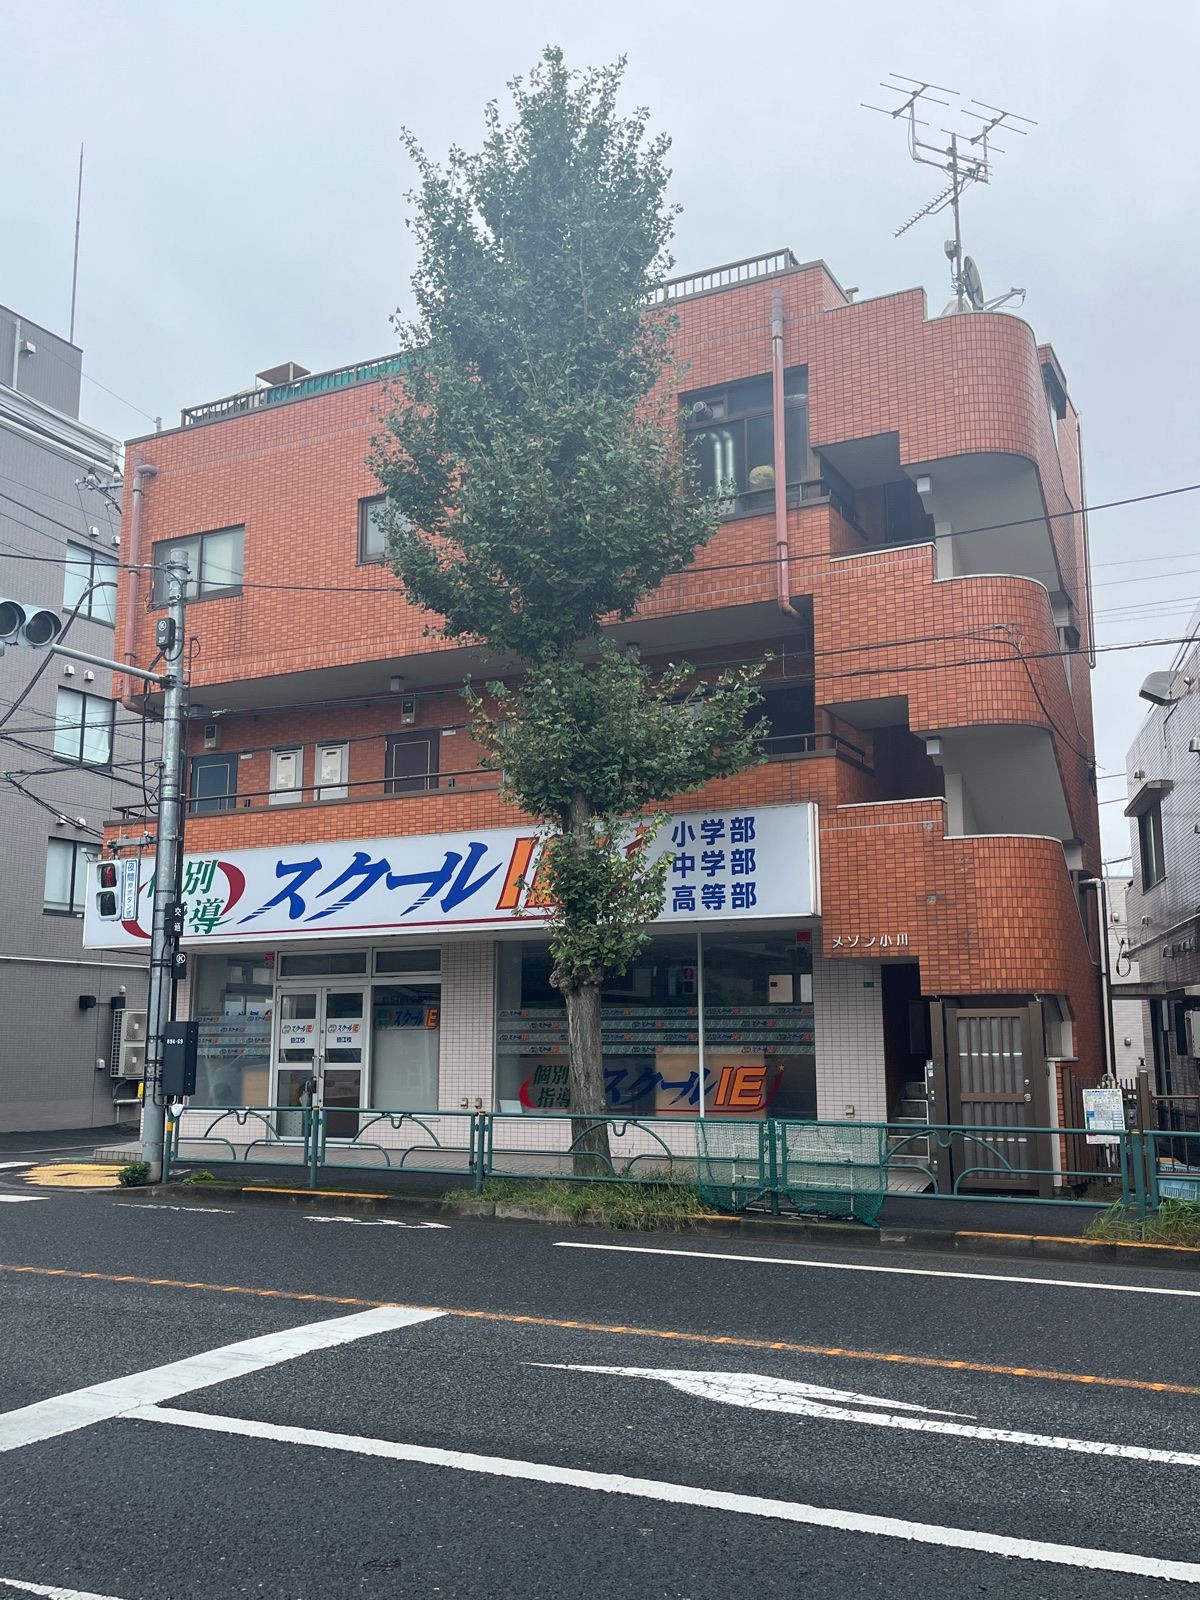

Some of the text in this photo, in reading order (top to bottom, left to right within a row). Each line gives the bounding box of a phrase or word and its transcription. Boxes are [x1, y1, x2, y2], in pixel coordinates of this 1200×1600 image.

[671, 816, 756, 848] 小学部
[147, 859, 218, 898] 別
[672, 848, 758, 880] 中学部
[672, 882, 758, 913] 高等部
[533, 1064, 569, 1085] 個別
